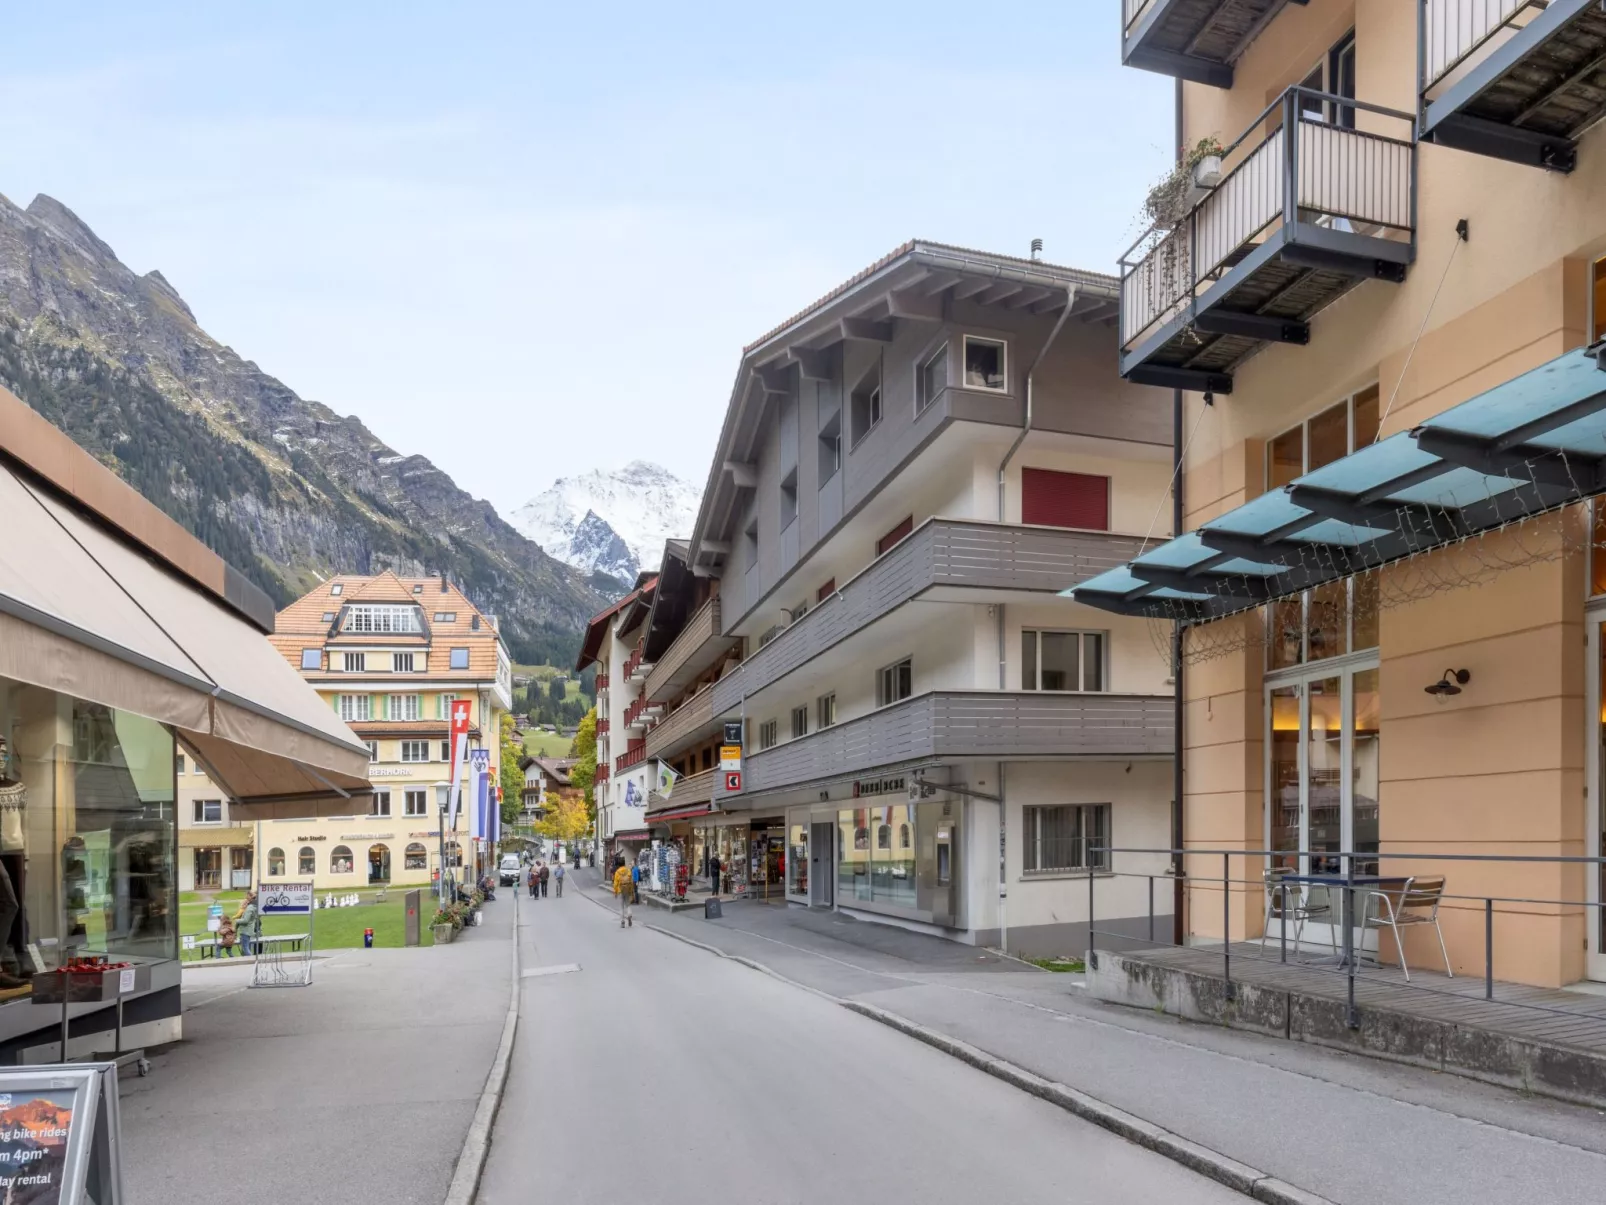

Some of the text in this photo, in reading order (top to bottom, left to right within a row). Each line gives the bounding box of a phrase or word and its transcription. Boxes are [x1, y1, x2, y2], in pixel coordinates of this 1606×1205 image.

[261, 884, 310, 892] Bike Rental
[13, 1128, 37, 1140] bike
[39, 1127, 67, 1138] rides
[17, 1172, 51, 1185] rental
